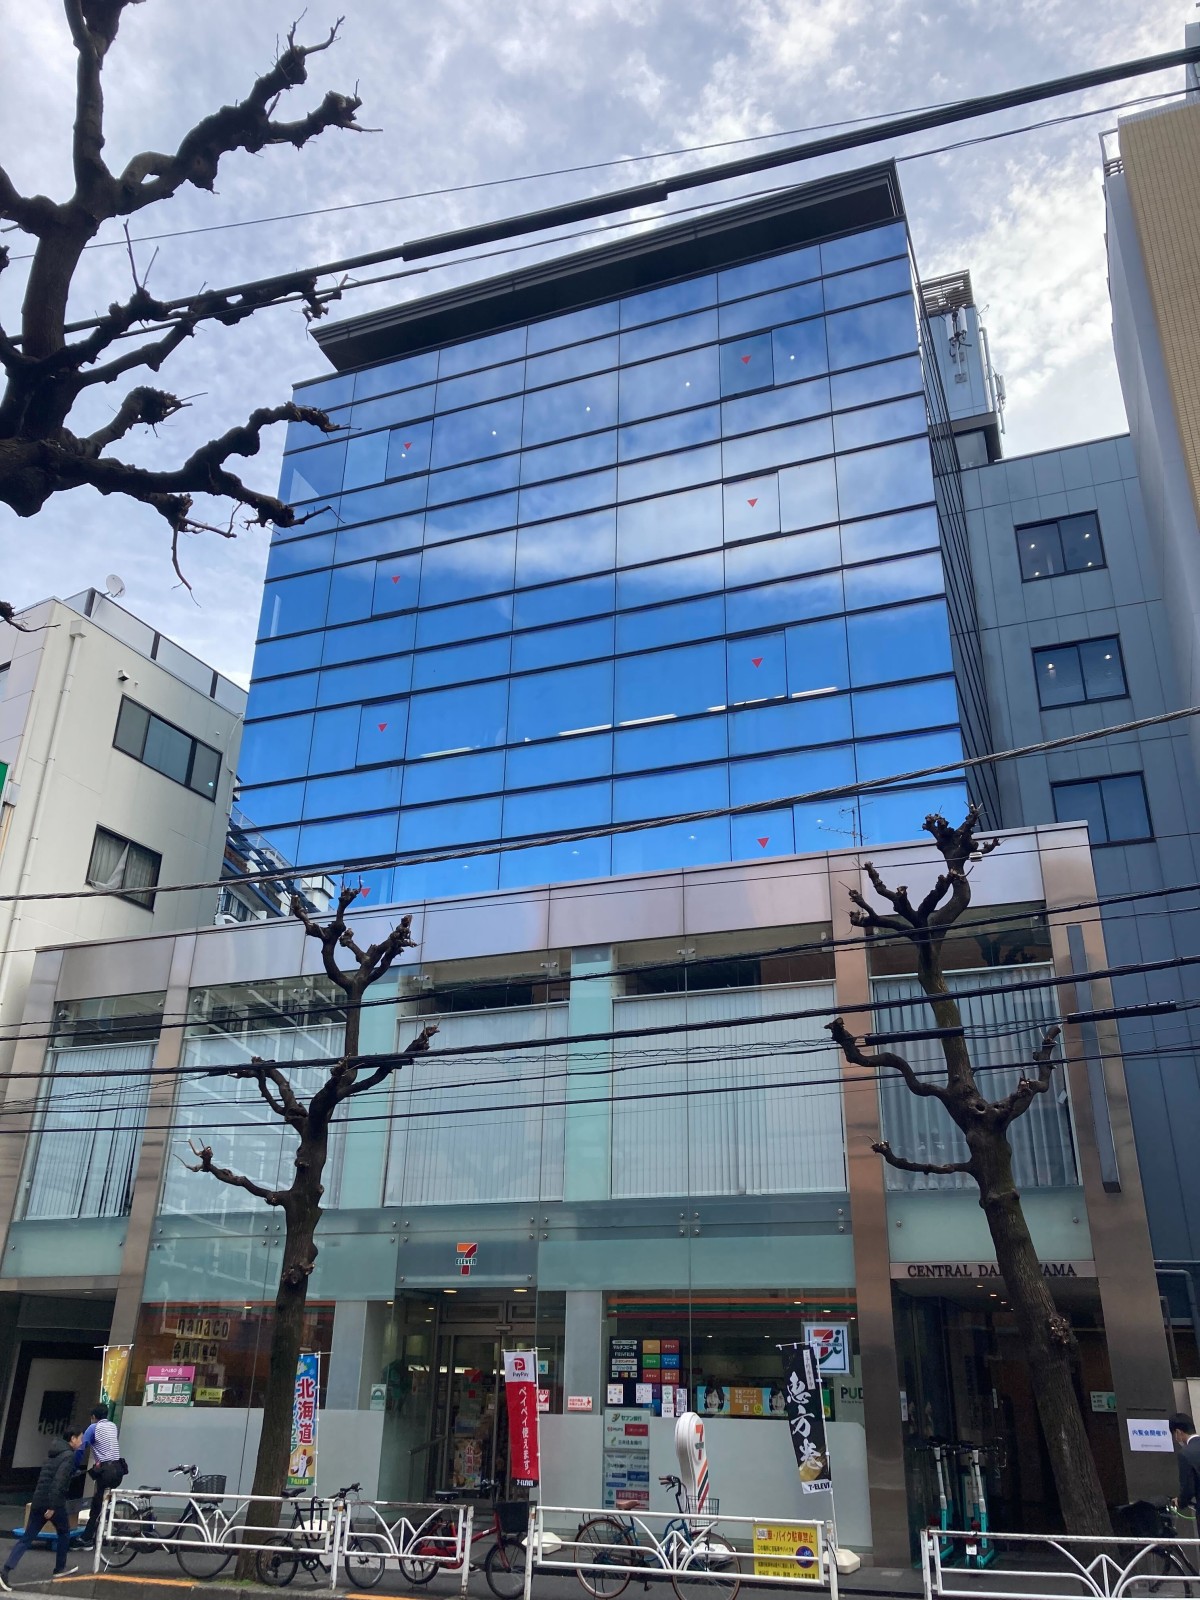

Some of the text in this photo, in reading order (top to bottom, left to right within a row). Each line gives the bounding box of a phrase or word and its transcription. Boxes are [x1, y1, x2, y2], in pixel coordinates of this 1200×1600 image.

[907, 1264, 972, 1278] CENTRAL
[177, 1319, 230, 1338] nanaco
[297, 1378, 315, 1444] 北海道
[519, 1386, 531, 1475] ペイペイ使えます。
[757, 1529, 814, 1544] 車・バイク駐車禁止
